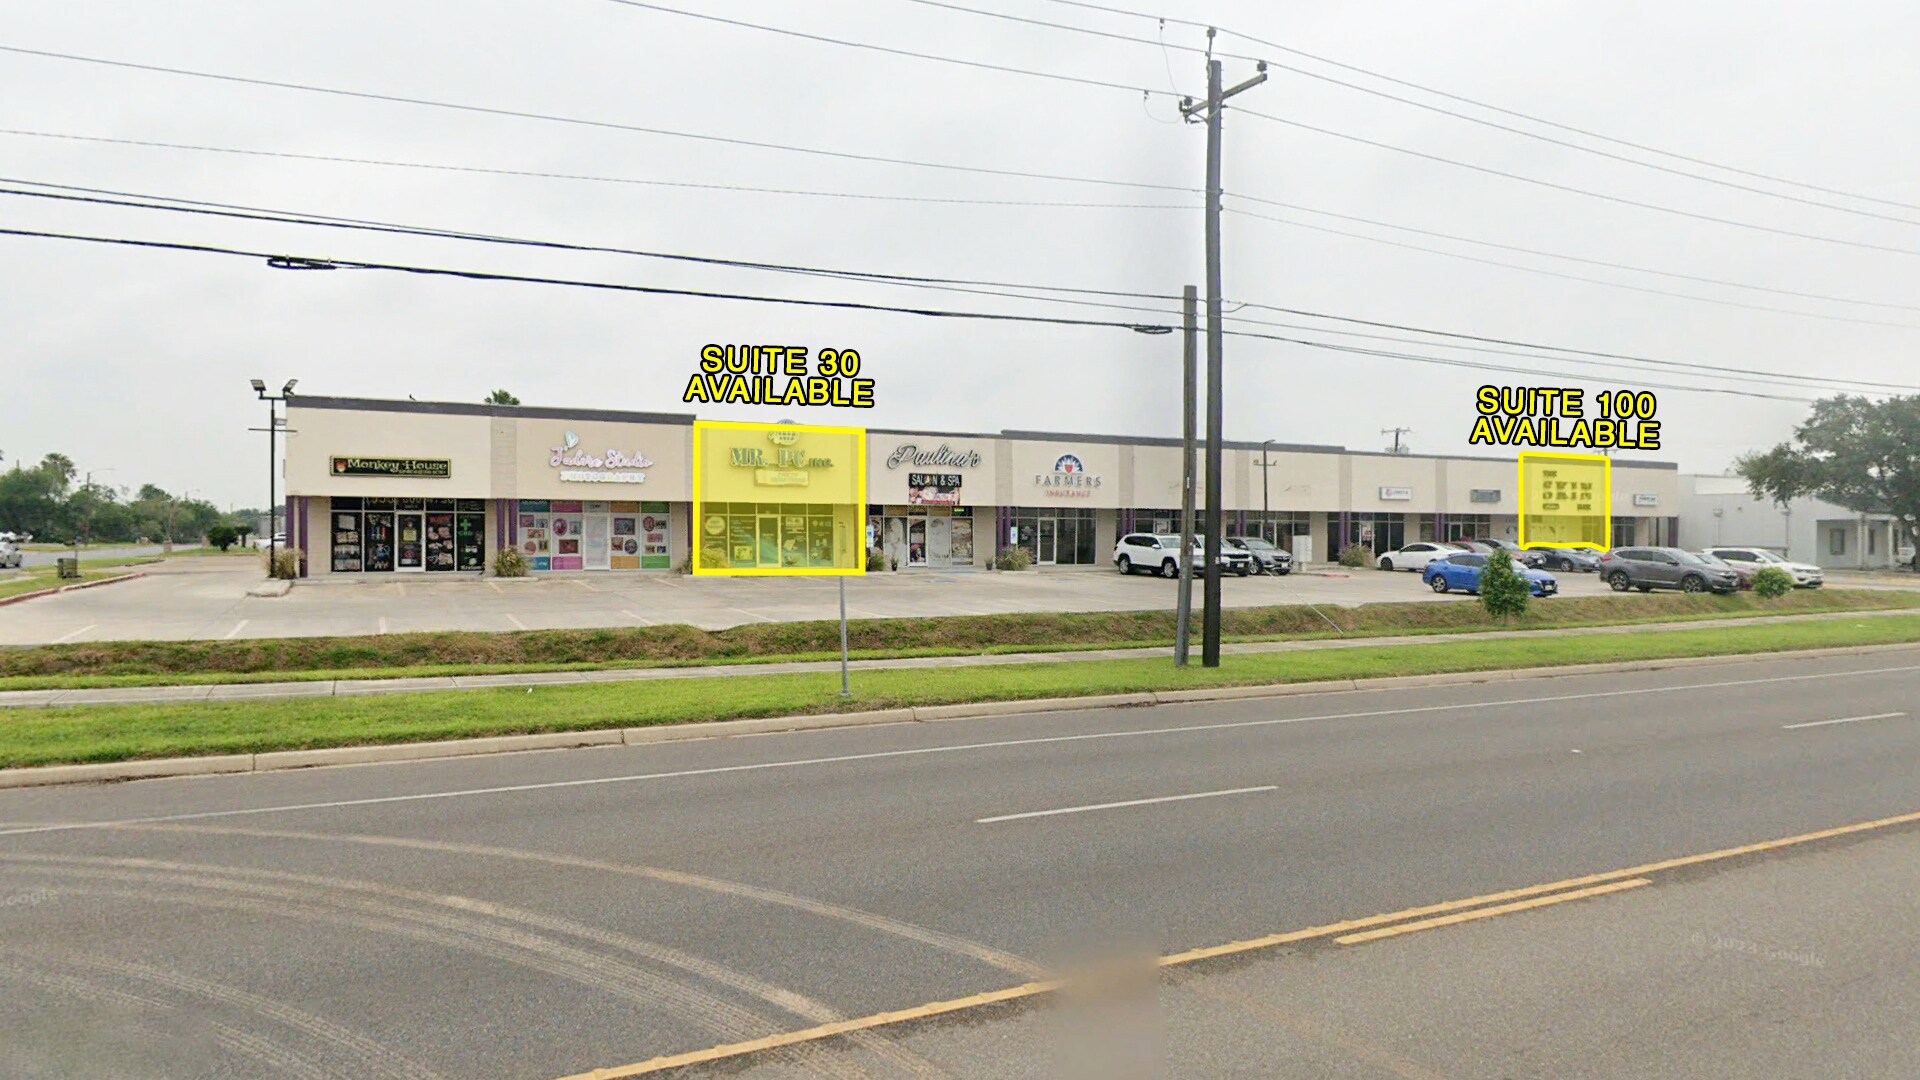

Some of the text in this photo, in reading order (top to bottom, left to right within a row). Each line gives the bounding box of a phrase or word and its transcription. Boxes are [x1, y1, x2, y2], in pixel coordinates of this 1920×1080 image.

[730, 447, 768, 468] MR.
[778, 447, 807, 468] PC
[887, 444, 982, 469] Paulina's
[347, 459, 399, 474] Monkey
[402, 460, 448, 470] House
[947, 475, 960, 486] SPA
[1035, 474, 1102, 488] FARMERS
